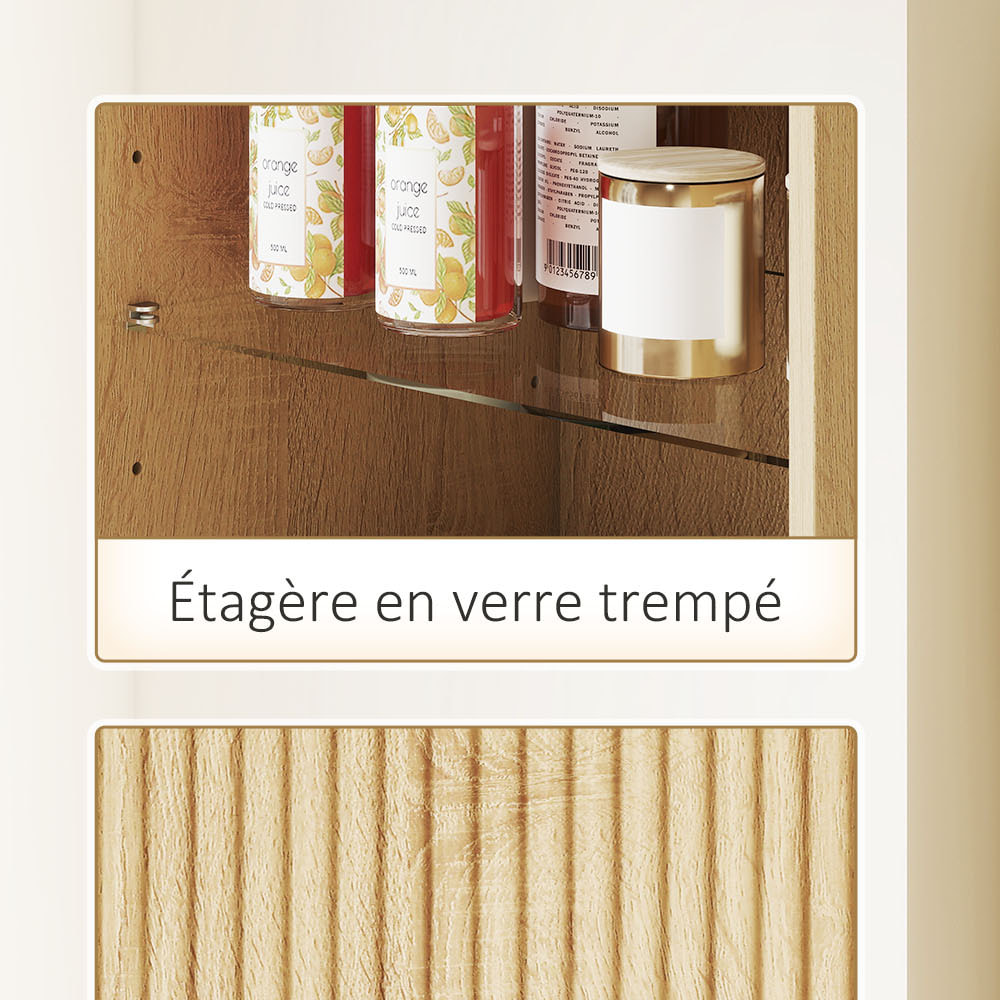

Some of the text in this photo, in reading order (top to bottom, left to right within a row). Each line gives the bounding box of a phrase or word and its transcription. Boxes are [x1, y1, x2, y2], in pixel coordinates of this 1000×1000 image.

[262, 158, 298, 176] orange
[267, 181, 290, 198] juice
[390, 178, 428, 197] orange
[274, 202, 297, 212] PRESSED
[396, 201, 420, 219] juice
[404, 224, 427, 234] PRESSED
